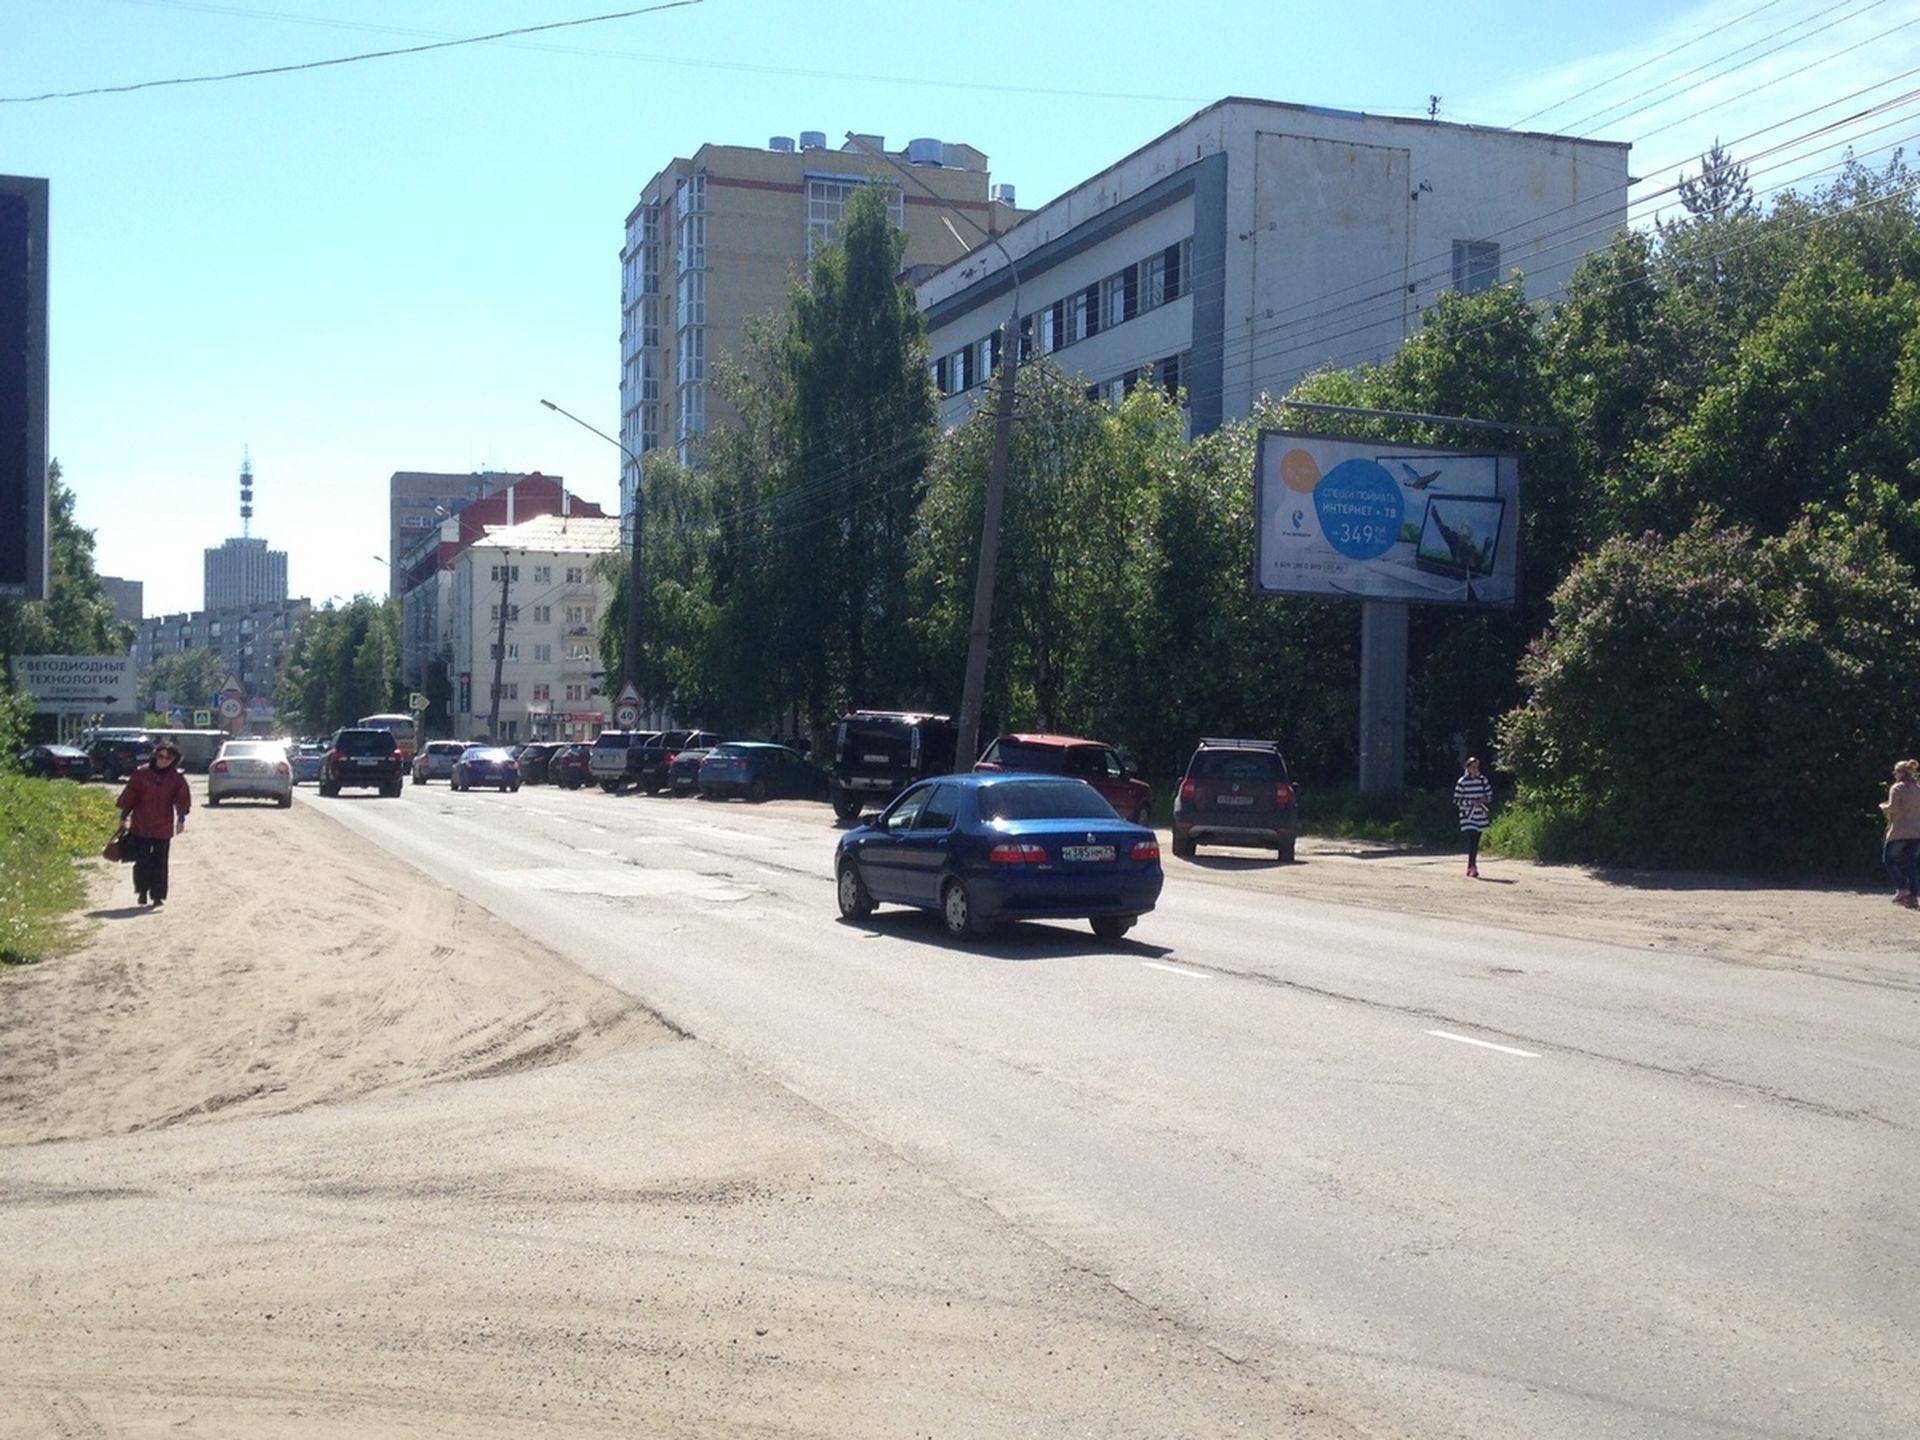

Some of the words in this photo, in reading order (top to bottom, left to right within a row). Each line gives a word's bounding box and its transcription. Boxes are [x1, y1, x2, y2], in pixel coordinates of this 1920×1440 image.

[1322, 503, 1373, 516] ИНТЕРНЕТ
[1384, 507, 1397, 518] ТВ
[1340, 523, 1373, 543] 349
[30, 674, 119, 685] ТЕХНОЛОГИИ
[225, 703, 238, 713] 40
[620, 711, 634, 720] 40
